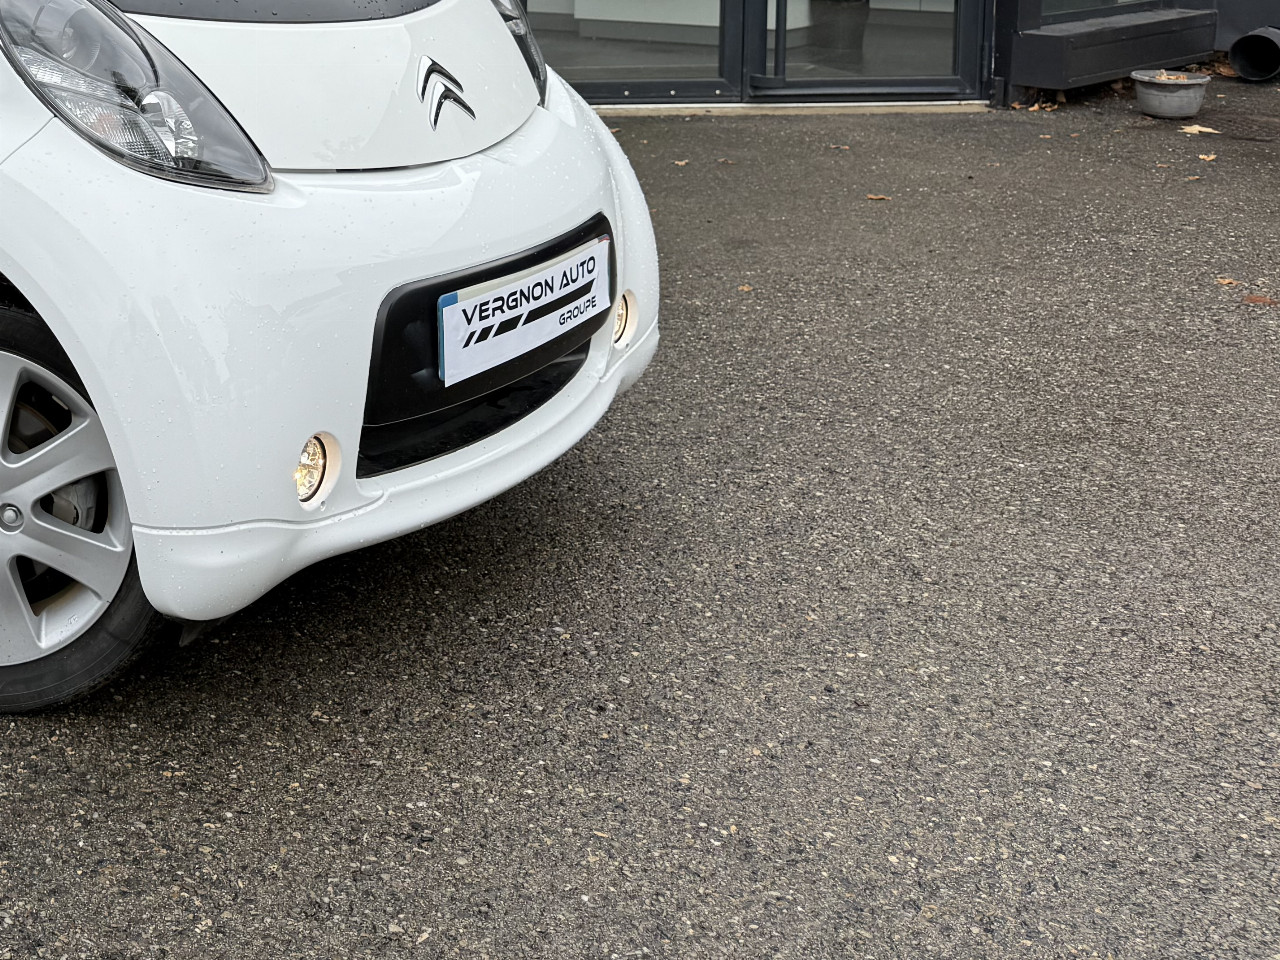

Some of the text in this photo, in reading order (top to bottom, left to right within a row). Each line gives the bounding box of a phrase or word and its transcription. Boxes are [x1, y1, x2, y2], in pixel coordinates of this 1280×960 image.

[461, 255, 597, 327] VERGNON AUTO
[558, 294, 597, 326] GROUPE
